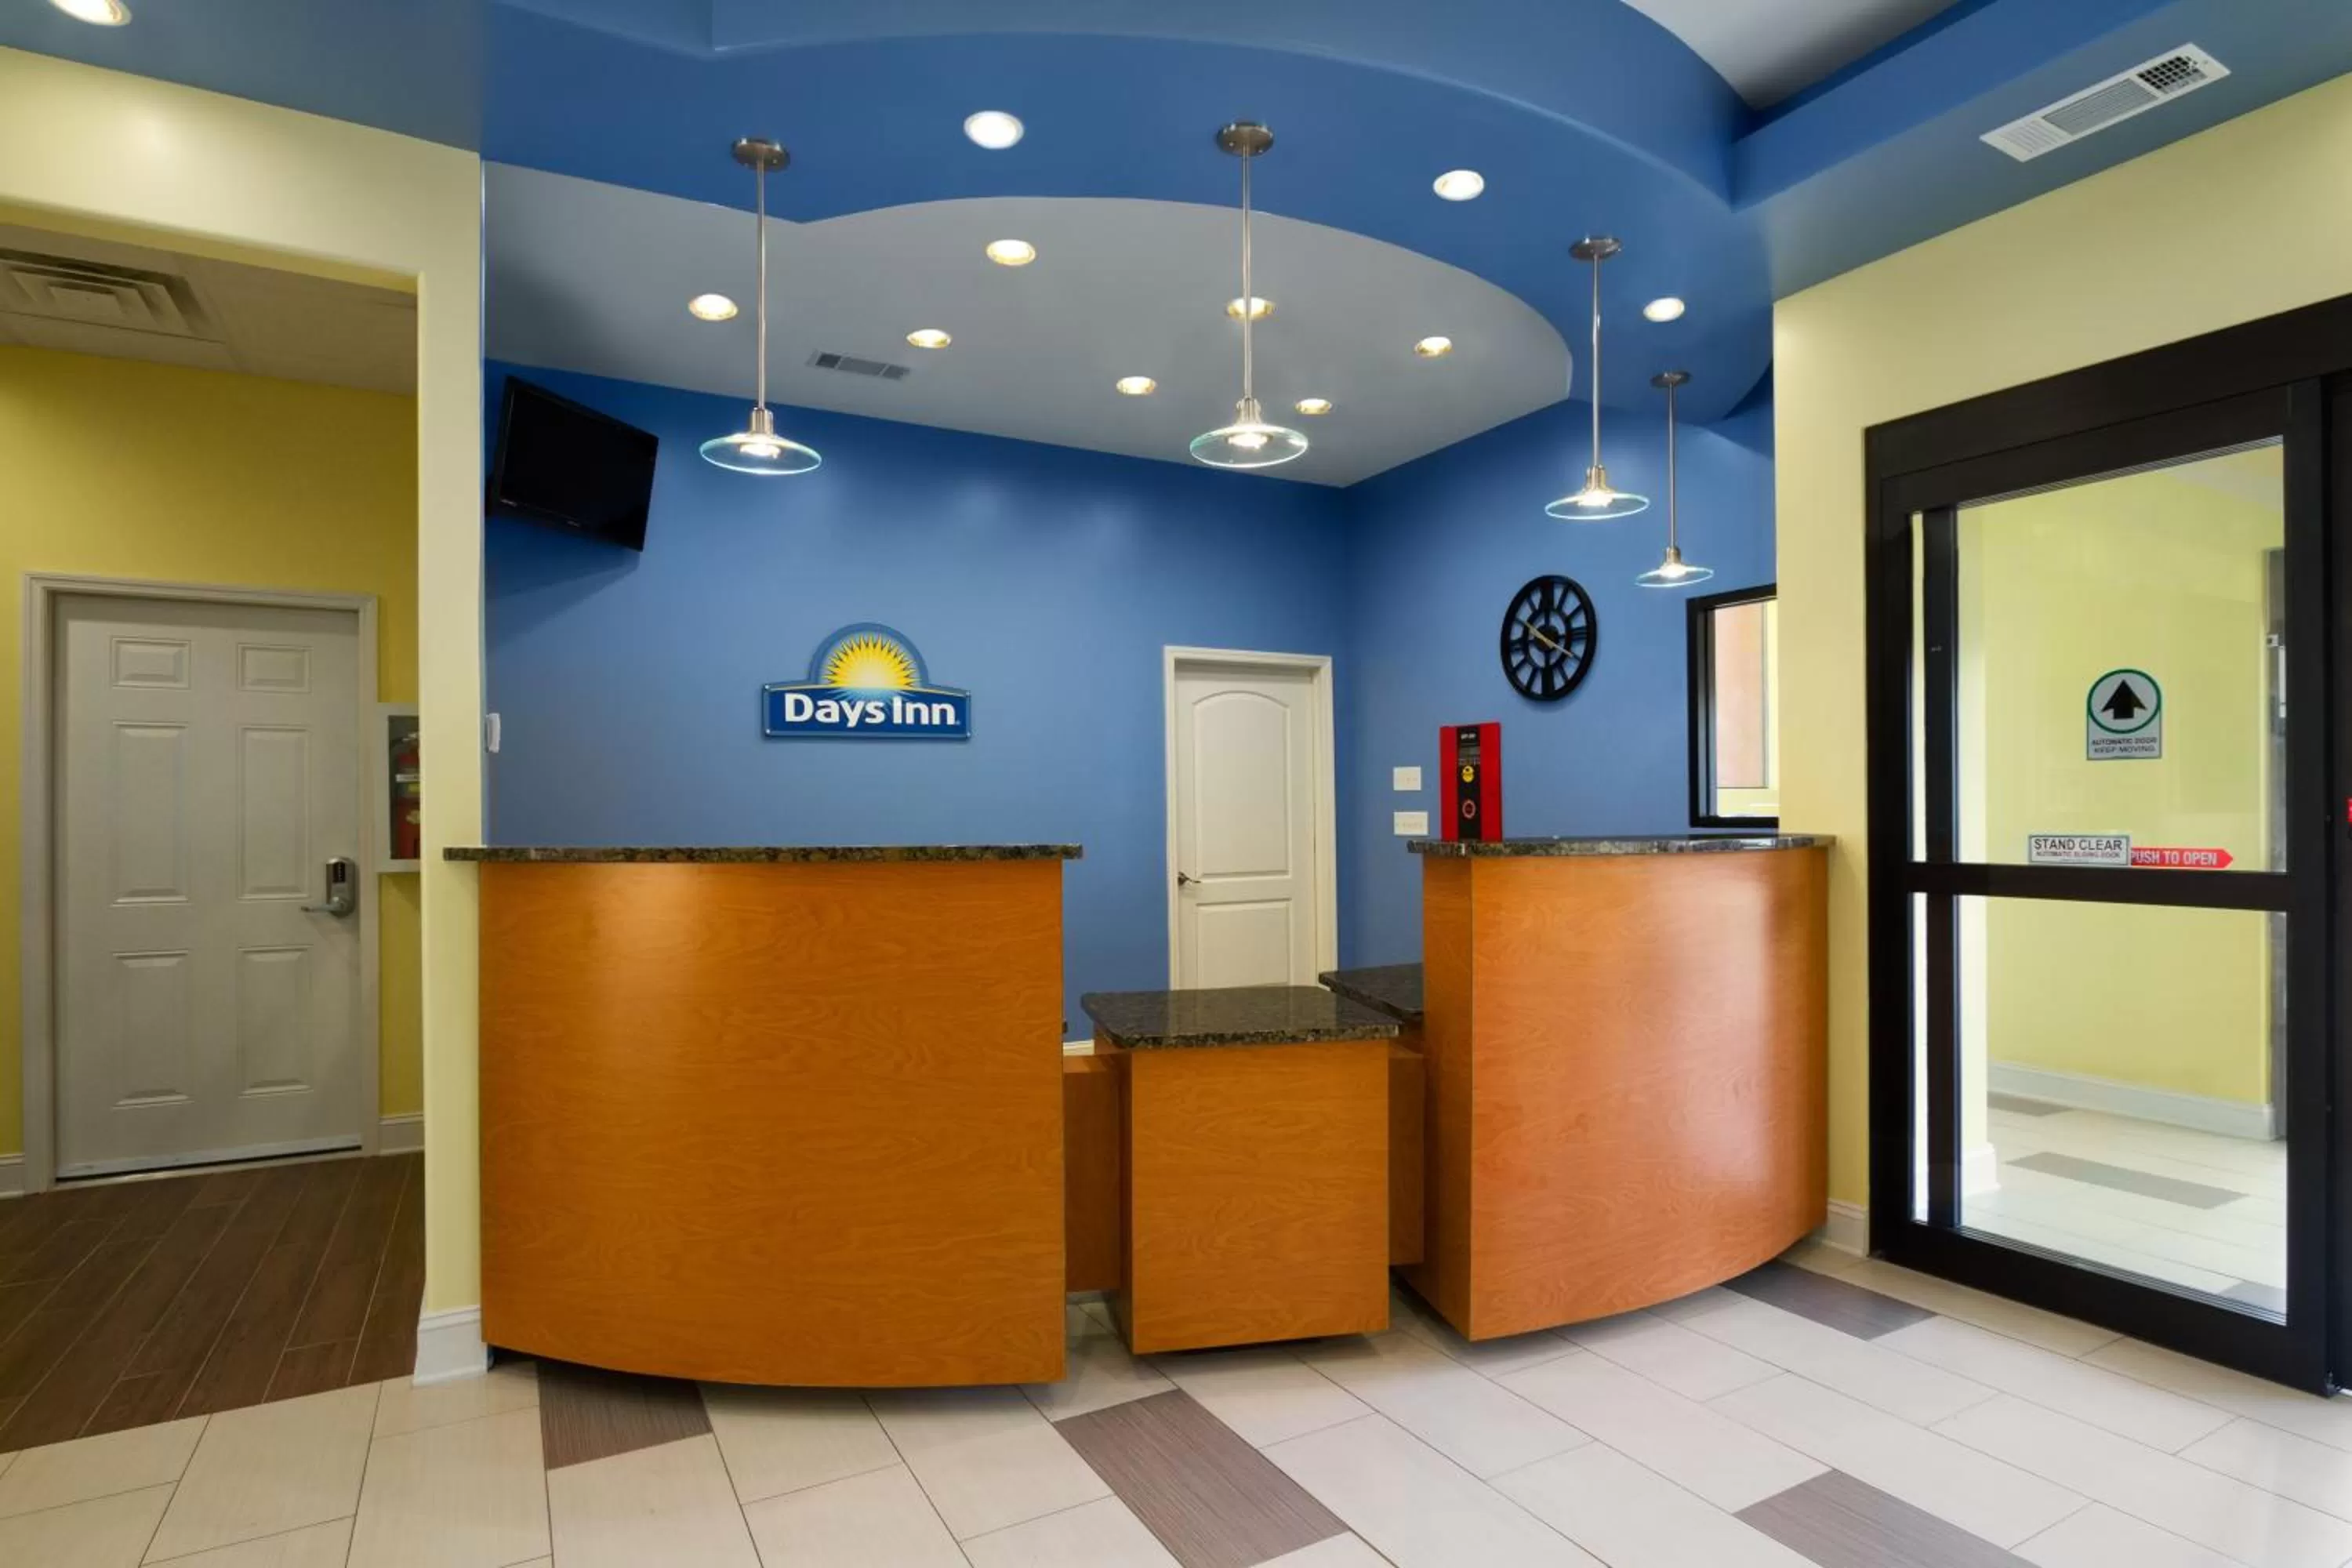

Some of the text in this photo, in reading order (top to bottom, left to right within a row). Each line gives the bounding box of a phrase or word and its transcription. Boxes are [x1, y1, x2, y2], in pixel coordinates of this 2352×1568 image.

[784, 693, 956, 728] Days Inn
[2119, 745, 2155, 753] MOVING
[2034, 839, 2122, 851] STAND CLEAR
[2164, 850, 2179, 865] TO
[2183, 851, 2217, 866] OPEN
